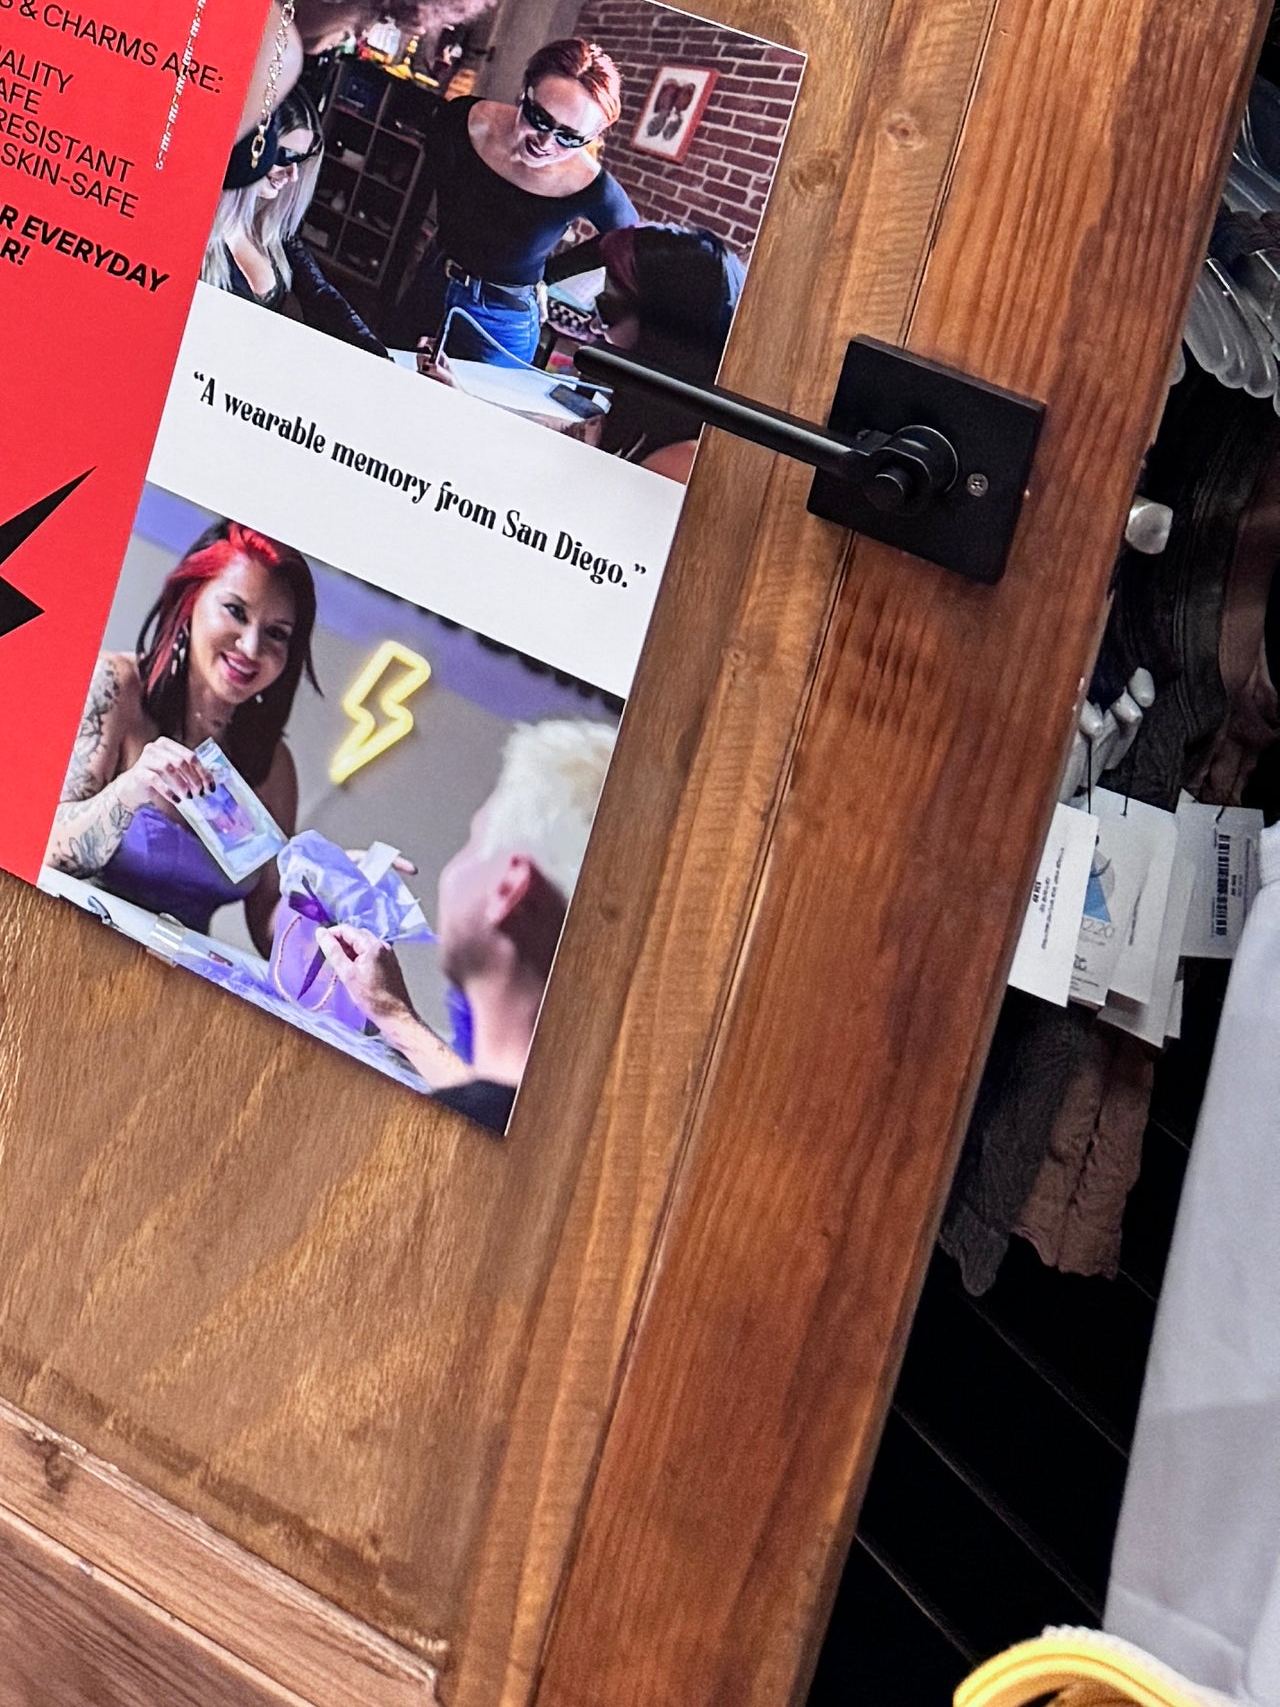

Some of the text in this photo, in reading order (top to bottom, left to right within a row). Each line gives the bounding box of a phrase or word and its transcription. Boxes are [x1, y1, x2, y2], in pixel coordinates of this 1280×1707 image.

[43, 4, 158, 66] CHARMS
[161, 48, 227, 94] ARE:
[0, 142, 139, 219] SKIN-SAFE
[20, 214, 170, 293] EVERYDAY
[224, 393, 326, 454] wearable
[331, 442, 432, 504] memory
[434, 481, 497, 530] from
[502, 509, 548, 553] San
